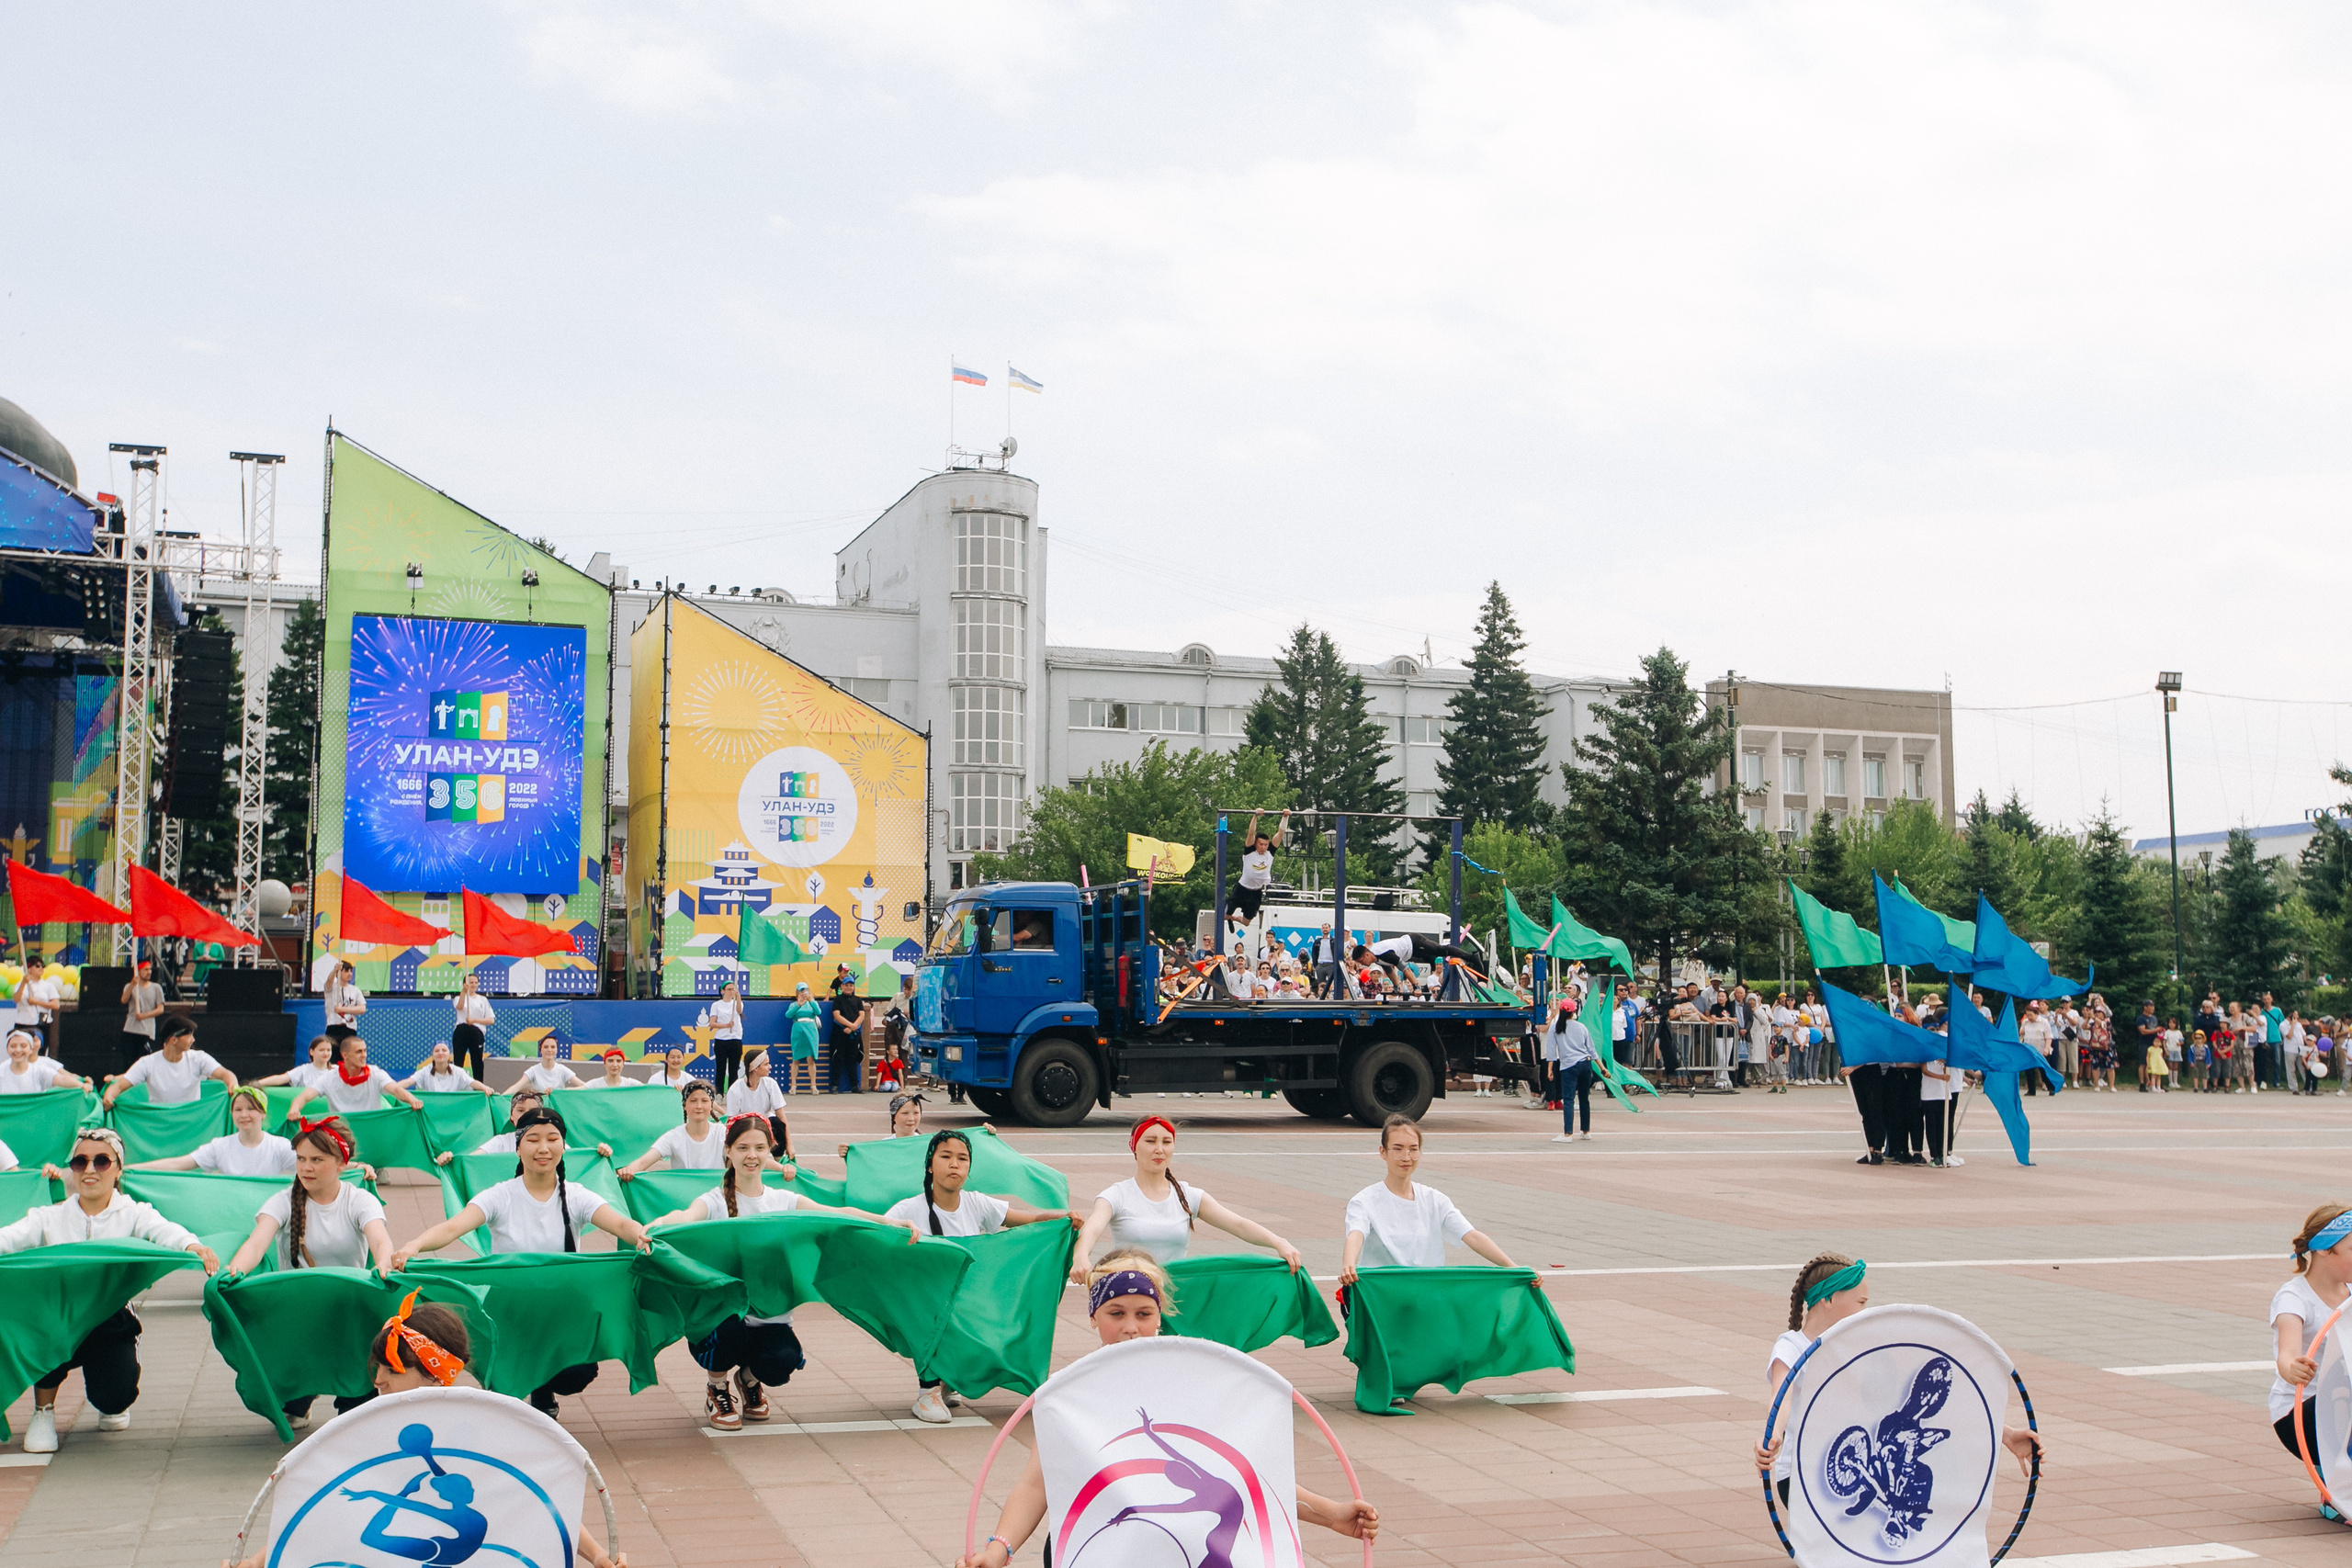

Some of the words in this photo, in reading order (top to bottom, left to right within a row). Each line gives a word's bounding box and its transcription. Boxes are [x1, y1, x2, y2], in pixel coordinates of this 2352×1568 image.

[394, 744, 539, 772] УЛАН-УДЭ
[397, 779, 423, 790] 1666
[508, 783, 537, 794] 2022
[429, 778, 503, 810] 356
[763, 801, 835, 815] УЛАН-УДЭ
[779, 818, 818, 836] 356
